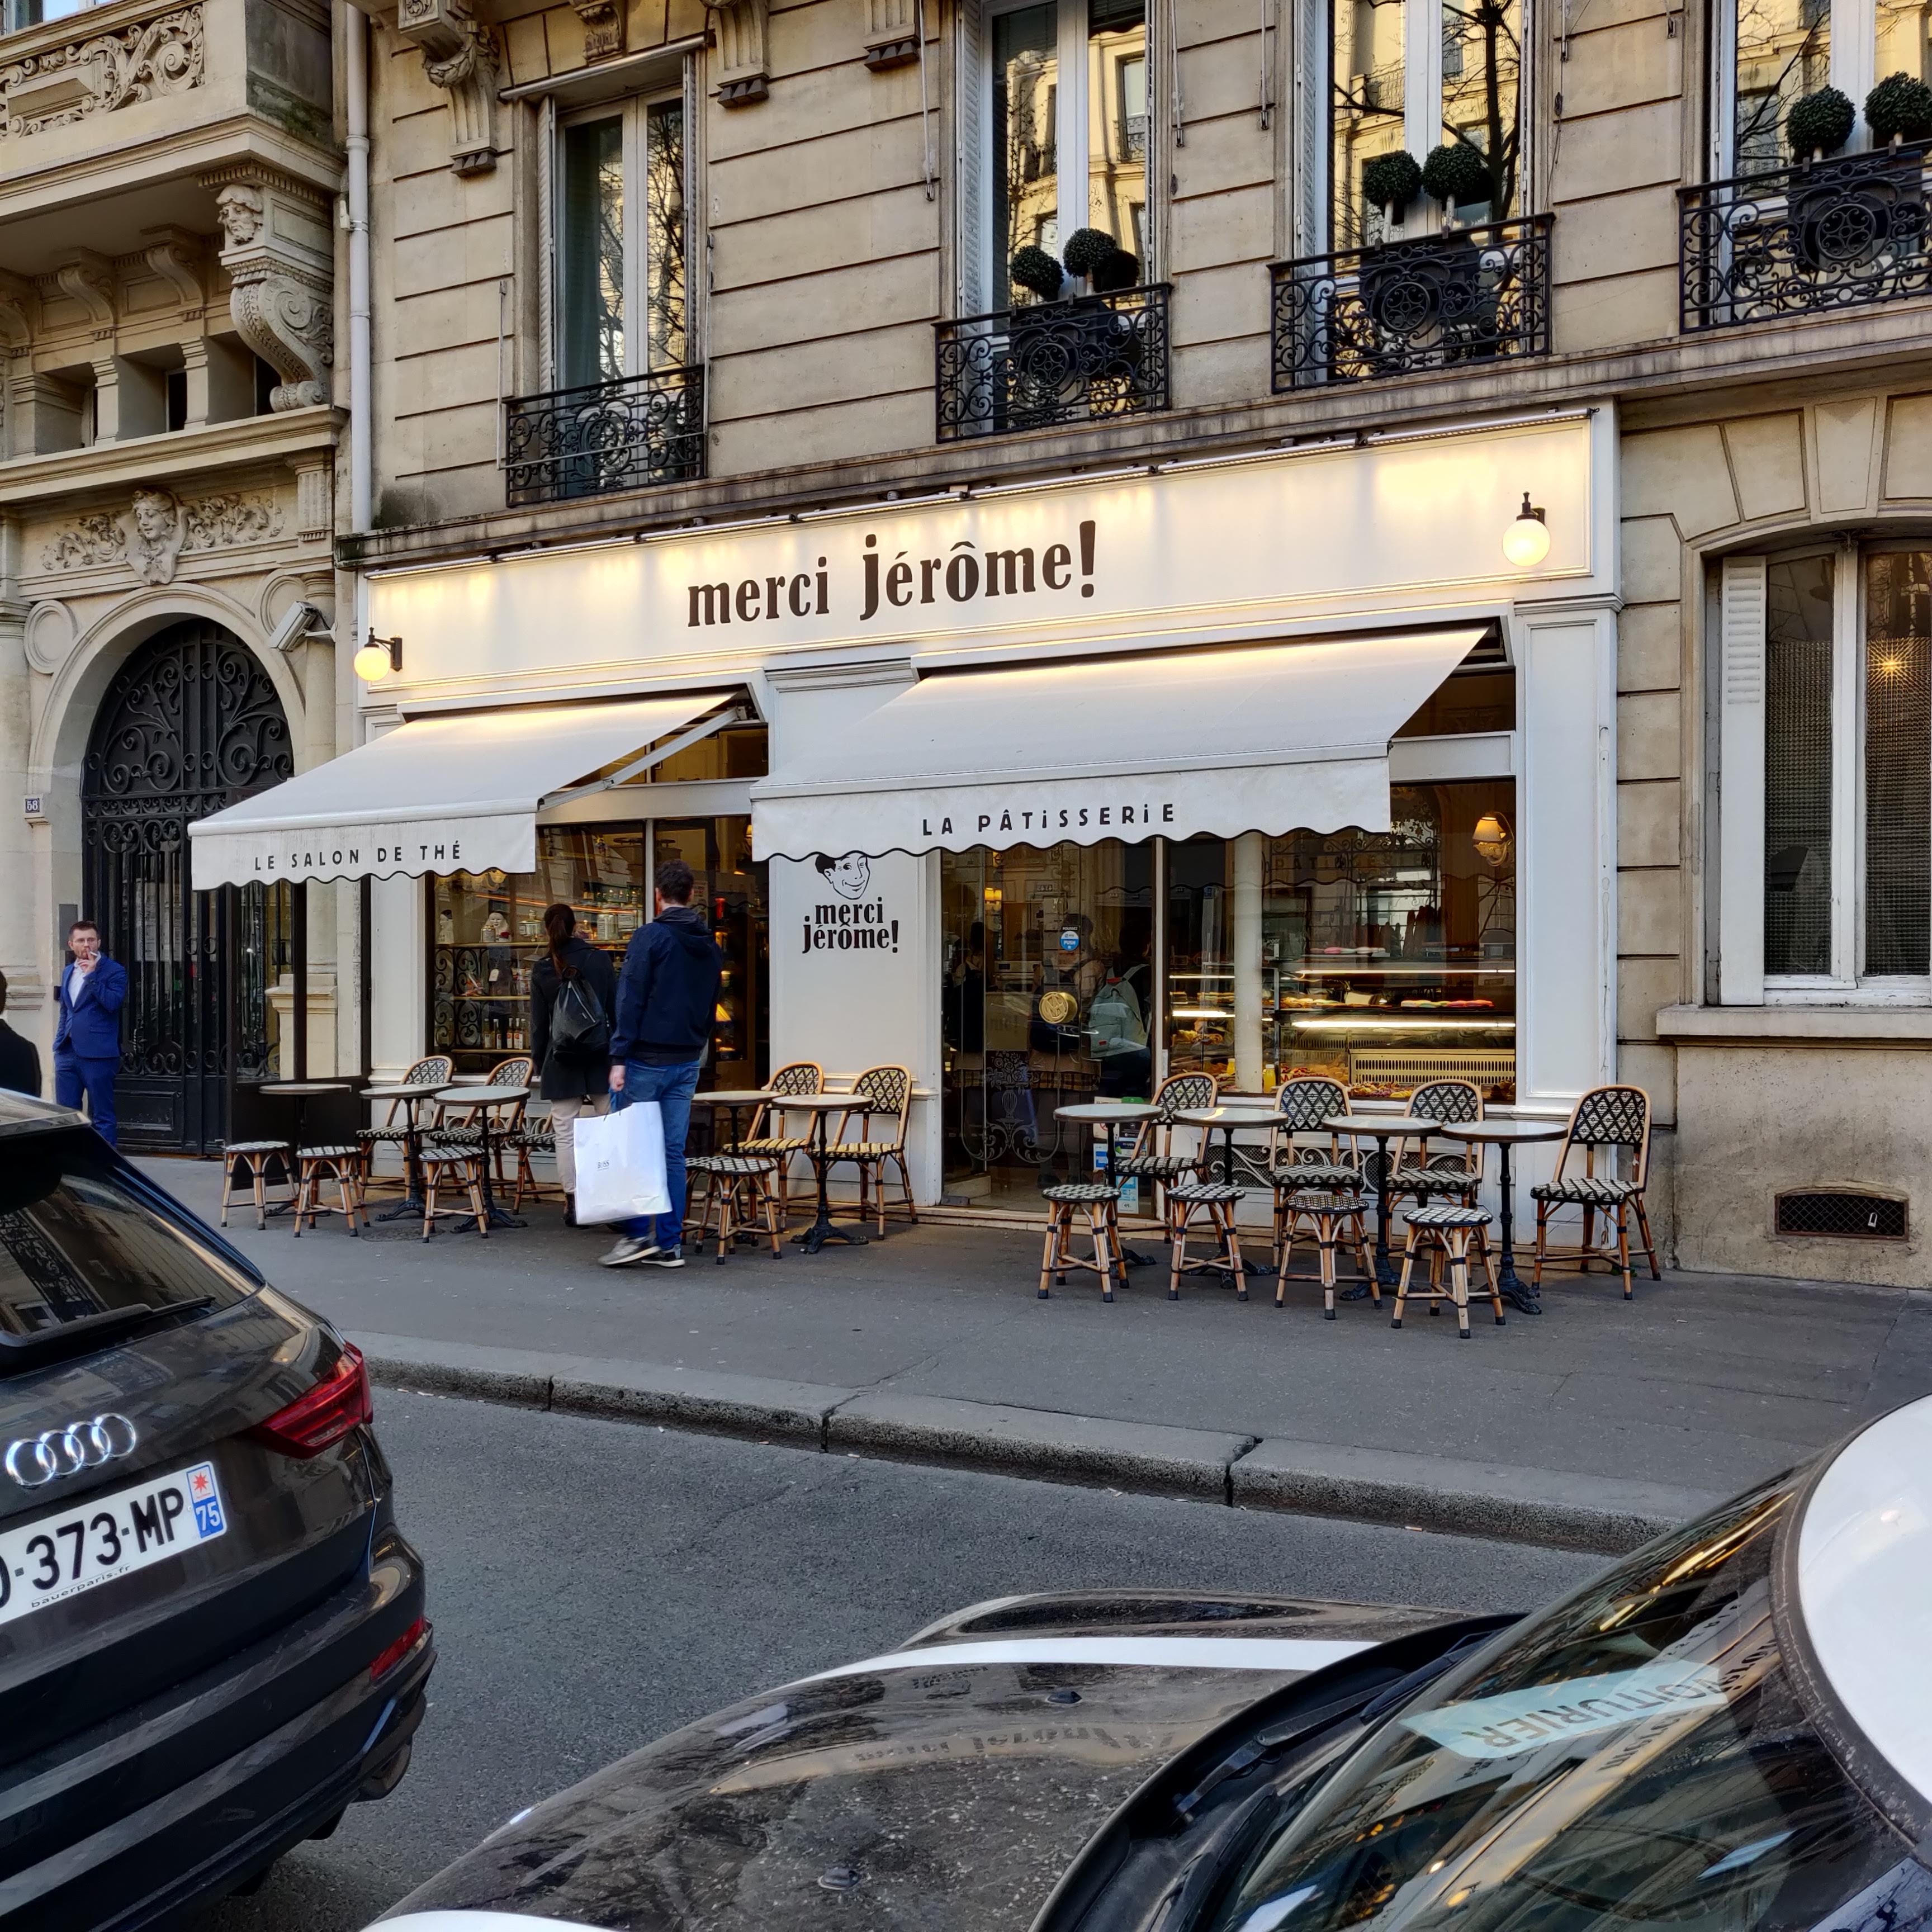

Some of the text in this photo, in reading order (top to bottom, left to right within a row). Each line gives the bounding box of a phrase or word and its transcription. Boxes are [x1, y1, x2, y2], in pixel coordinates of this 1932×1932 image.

[688, 520, 1096, 627] merci jérôme!
[26, 799, 39, 811] 58
[923, 817, 953, 836] LA
[255, 840, 461, 871] LE SALON DE THÉ
[814, 896, 884, 927] merci
[802, 915, 899, 954] jérôme!
[196, 1500, 221, 1531] 75
[31, 1564, 131, 1608] bauerparis.fr
[1461, 1677, 1722, 1748] VOITURIER
